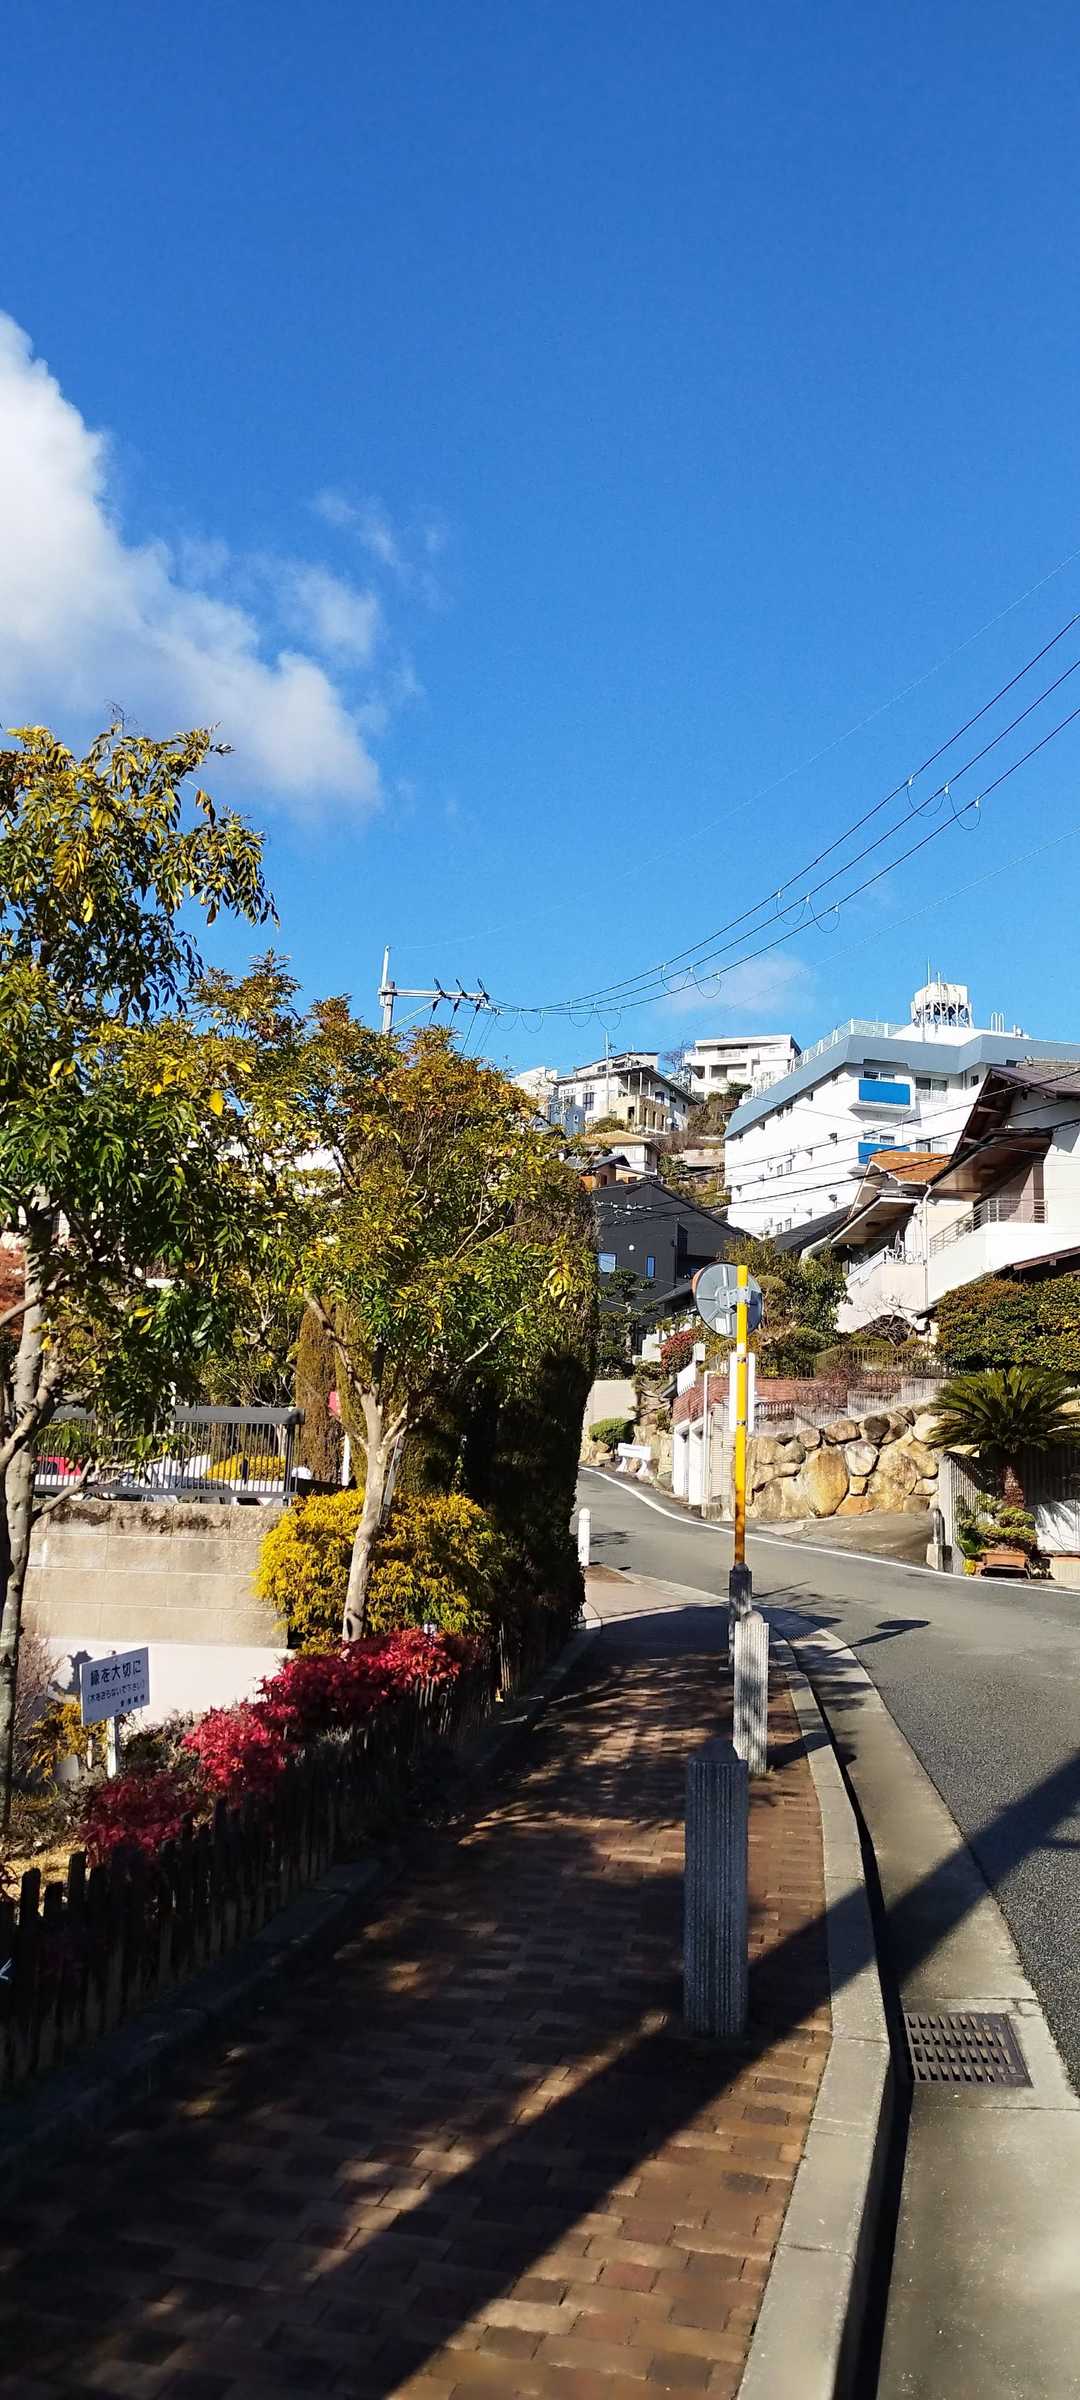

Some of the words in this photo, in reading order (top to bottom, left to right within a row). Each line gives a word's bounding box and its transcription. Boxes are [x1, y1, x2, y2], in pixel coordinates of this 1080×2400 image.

[90, 1660, 141, 1686] 緑を大切に
